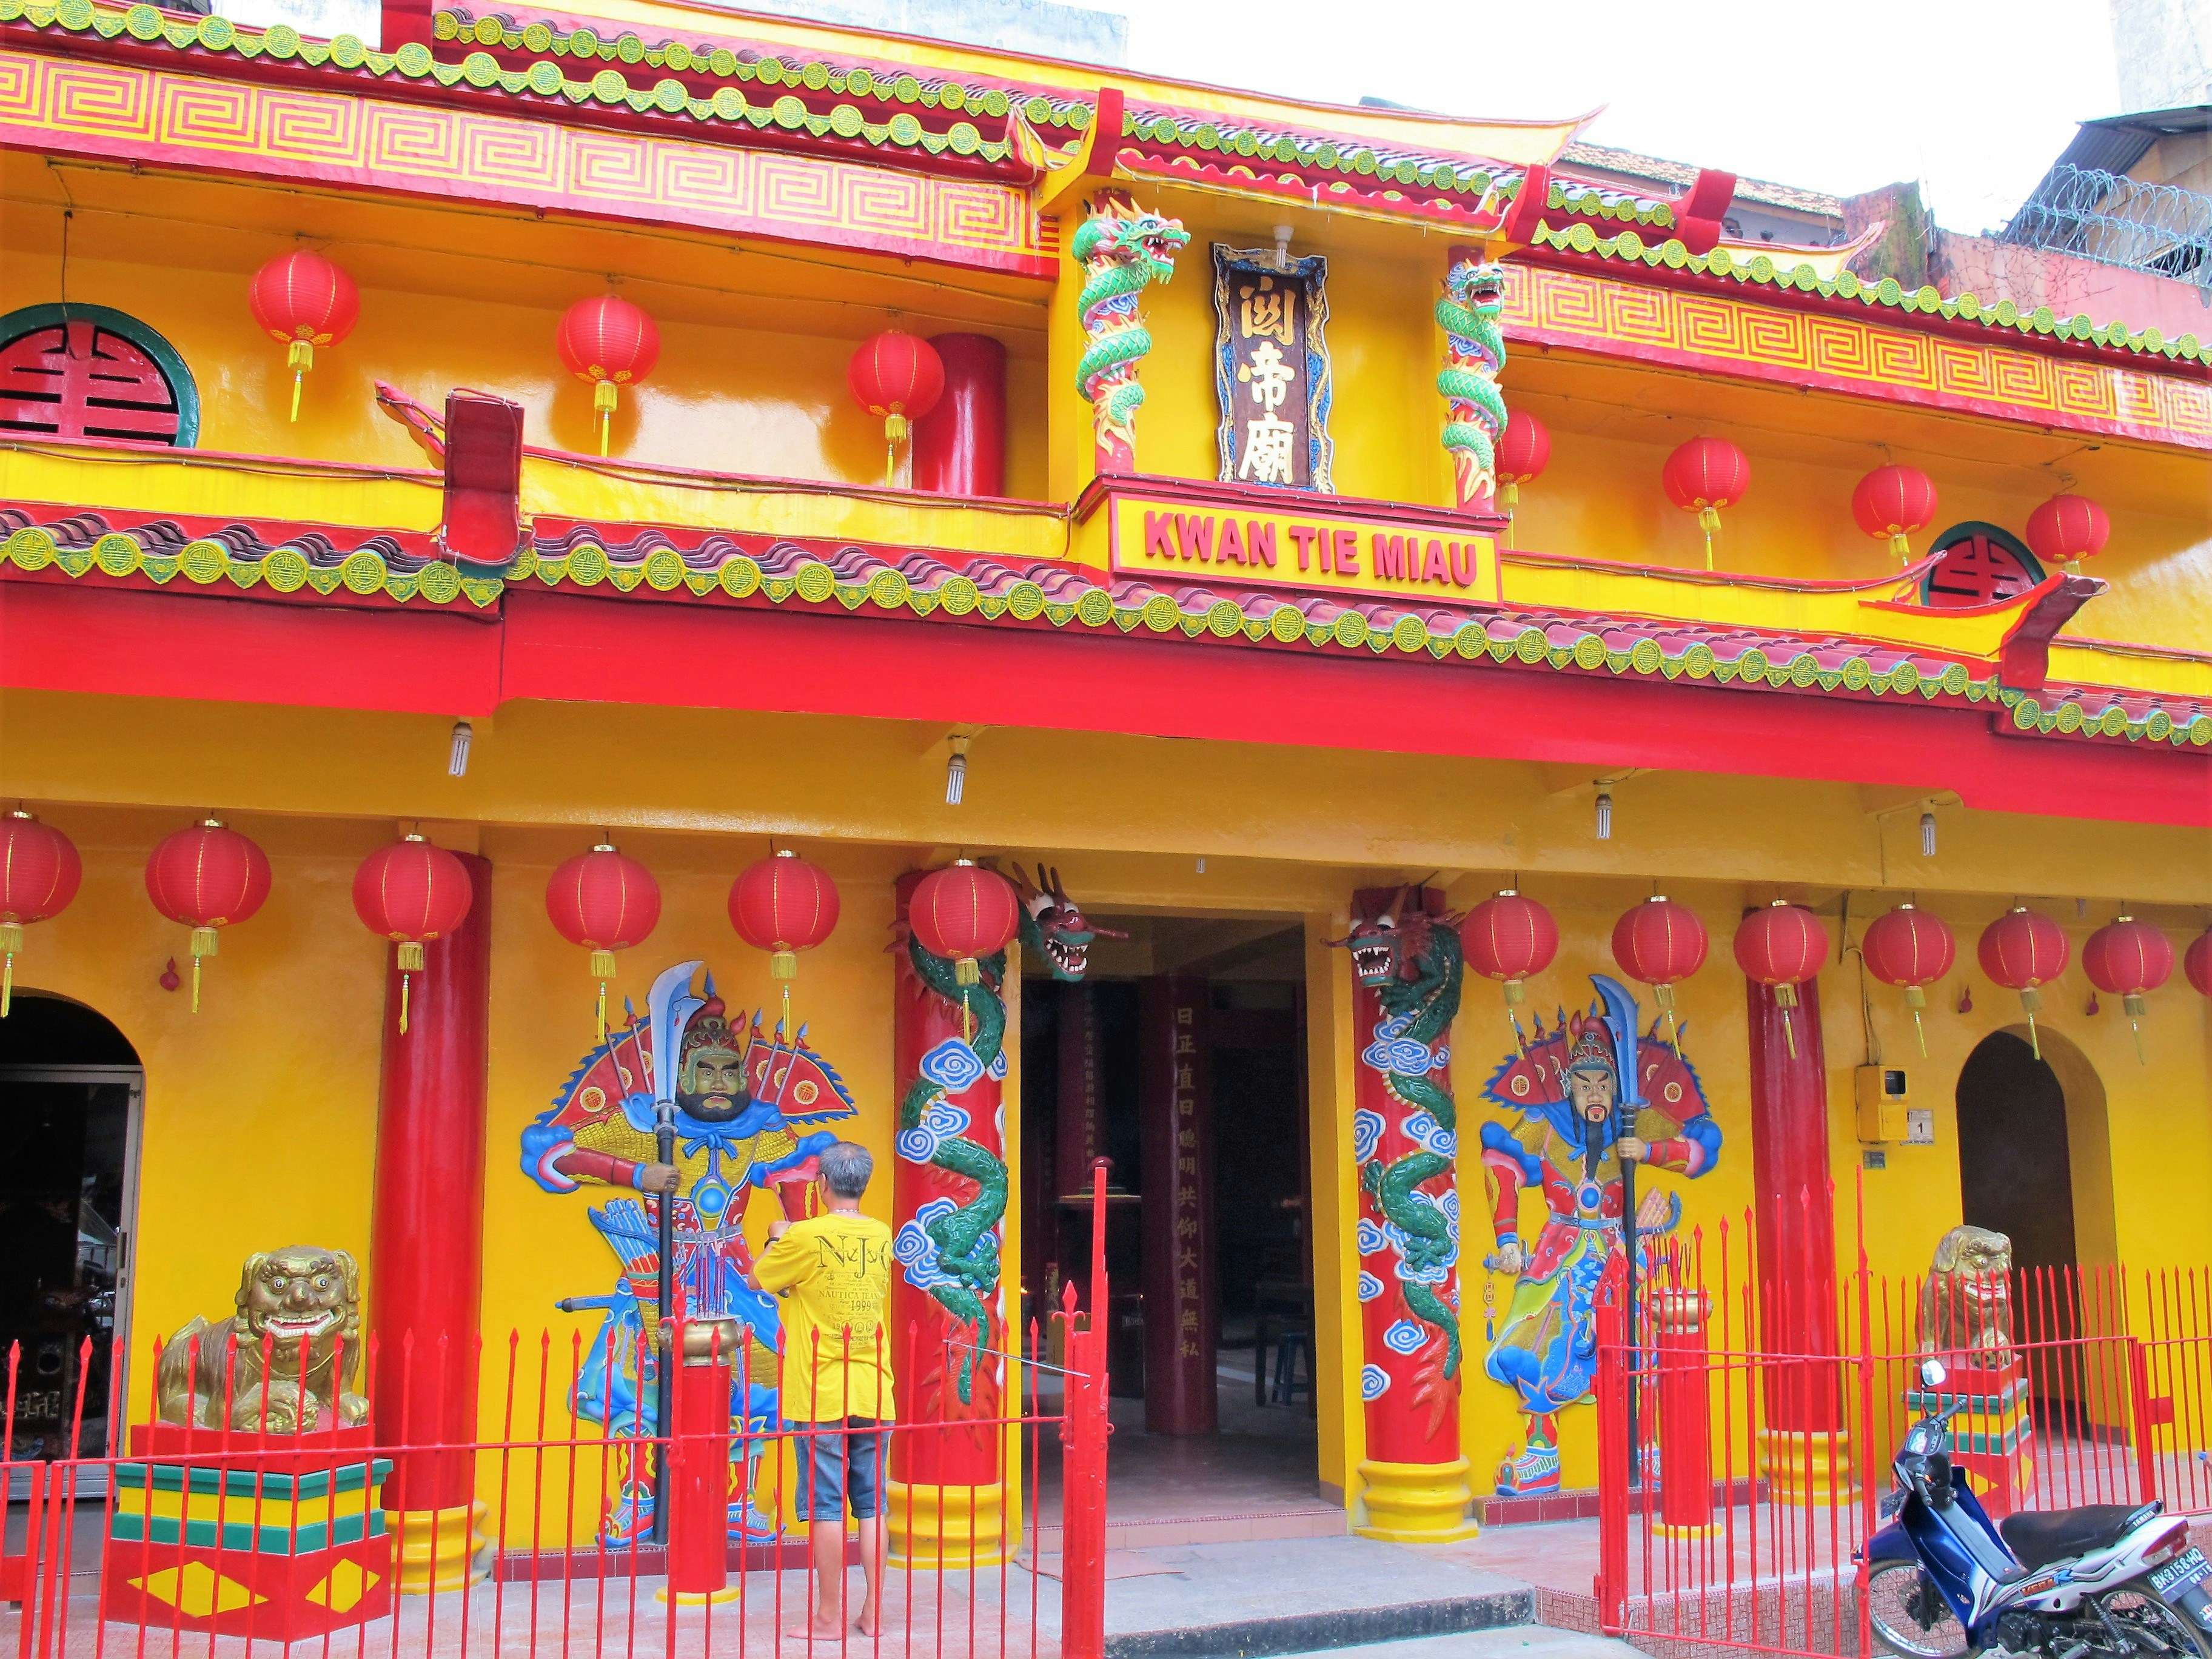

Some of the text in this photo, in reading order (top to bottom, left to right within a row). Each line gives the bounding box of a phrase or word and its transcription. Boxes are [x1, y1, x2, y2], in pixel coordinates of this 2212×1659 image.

[1144, 510, 1477, 588] KWAN TIE MIAU
[1917, 1122, 1923, 1133] 1
[819, 1290, 859, 1299] NAUTICA
[851, 1300, 871, 1312] 1999
[2133, 1510, 2156, 1527] YAMAHA
